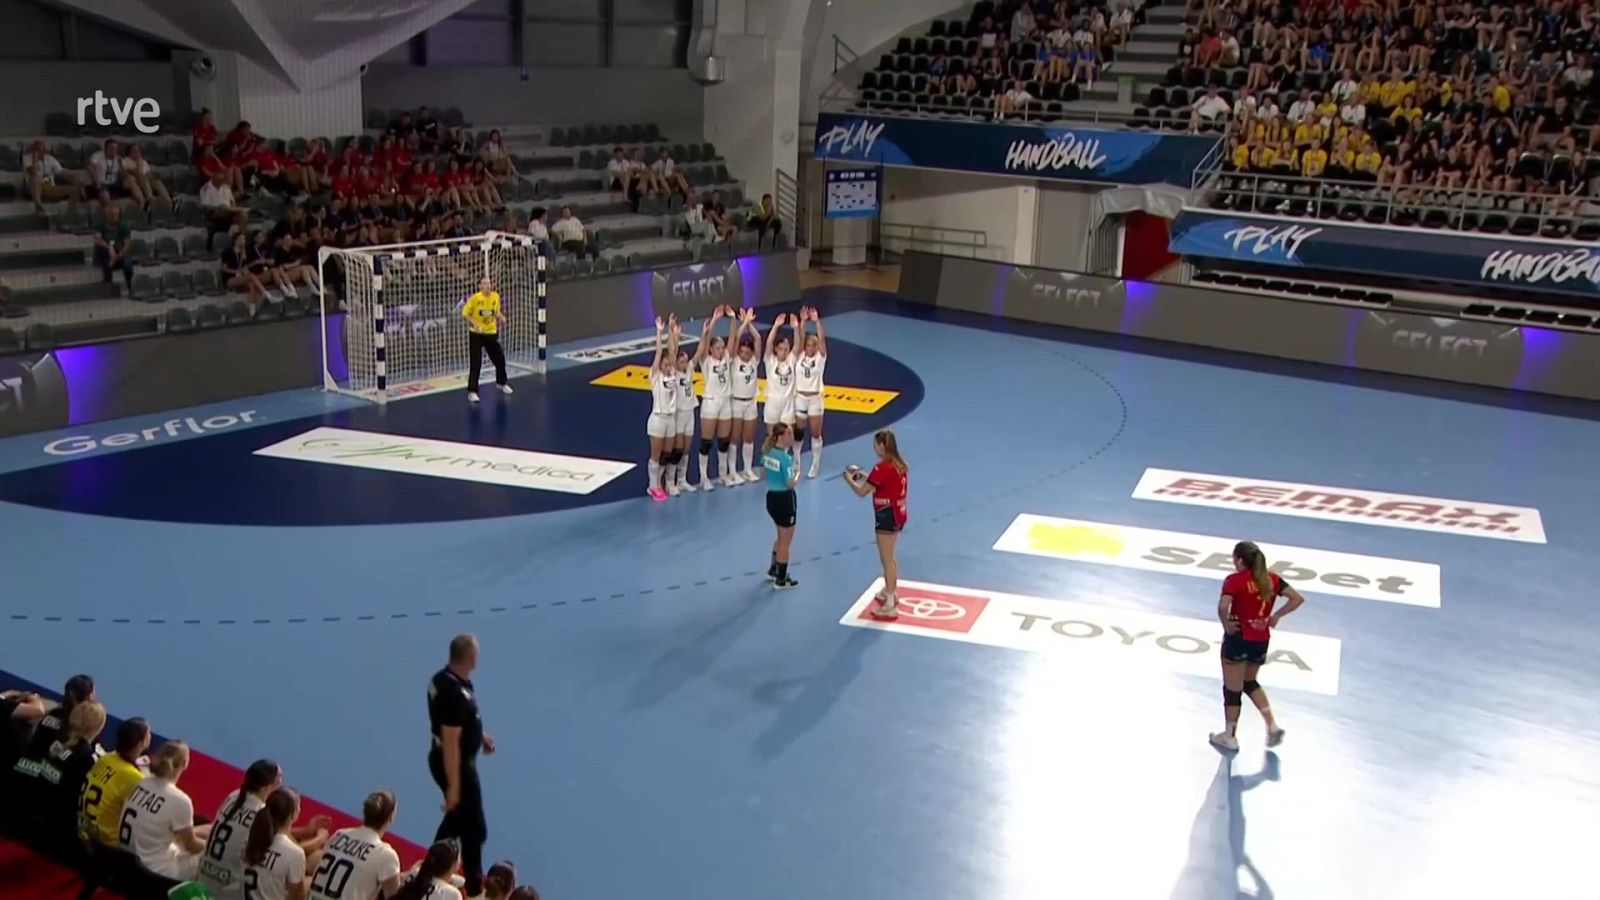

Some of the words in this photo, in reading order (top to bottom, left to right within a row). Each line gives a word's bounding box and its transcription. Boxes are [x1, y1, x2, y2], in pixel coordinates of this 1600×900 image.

[819, 119, 885, 158] PLAY
[1005, 132, 1106, 170] HANDBALL
[1224, 225, 1322, 260] PLAY
[43, 409, 256, 456] Gerflor
[1165, 477, 1521, 525] BEMAX
[1011, 612, 1313, 672] TOYOA
[120, 807, 137, 846] 6
[311, 853, 354, 899] 20
